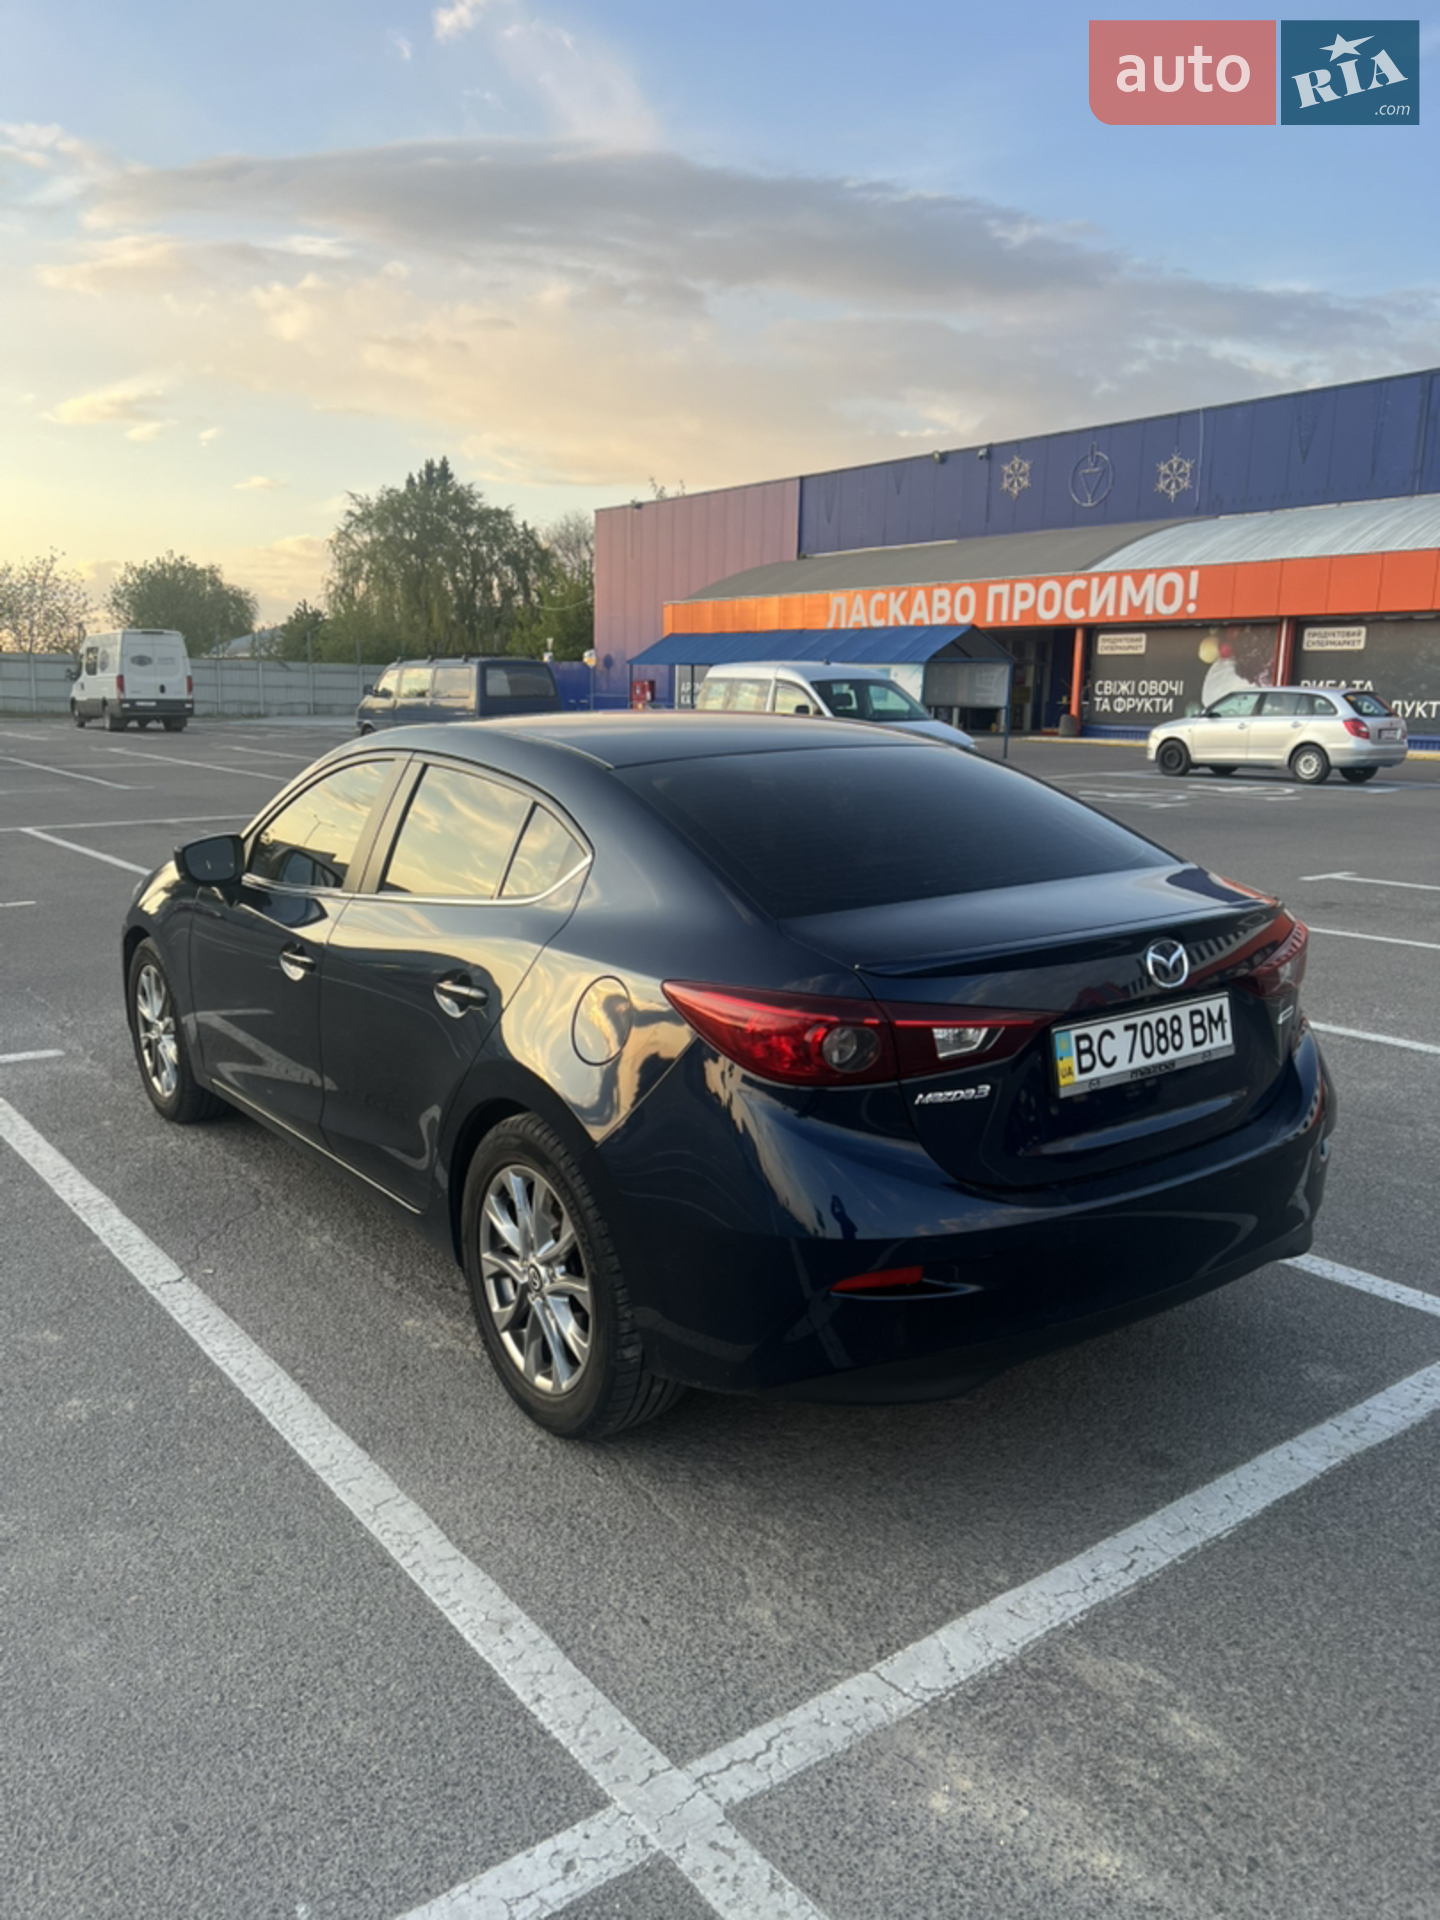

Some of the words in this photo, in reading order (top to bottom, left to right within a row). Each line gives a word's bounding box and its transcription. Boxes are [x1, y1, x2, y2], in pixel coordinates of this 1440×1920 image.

[826, 586, 977, 629] ЛАСКАВО
[985, 570, 1199, 623] ПРОСИМО!
[1094, 680, 1135, 696] СВІЖІ
[1138, 680, 1184, 696] ОВОЧІ
[1094, 697, 1111, 712] ТА
[1112, 696, 1174, 713] ФРУКТИ
[1074, 1029, 1117, 1075] BC
[1123, 1014, 1183, 1064] 7088
[1189, 1004, 1226, 1048] BM
[1060, 1066, 1074, 1079] UA
